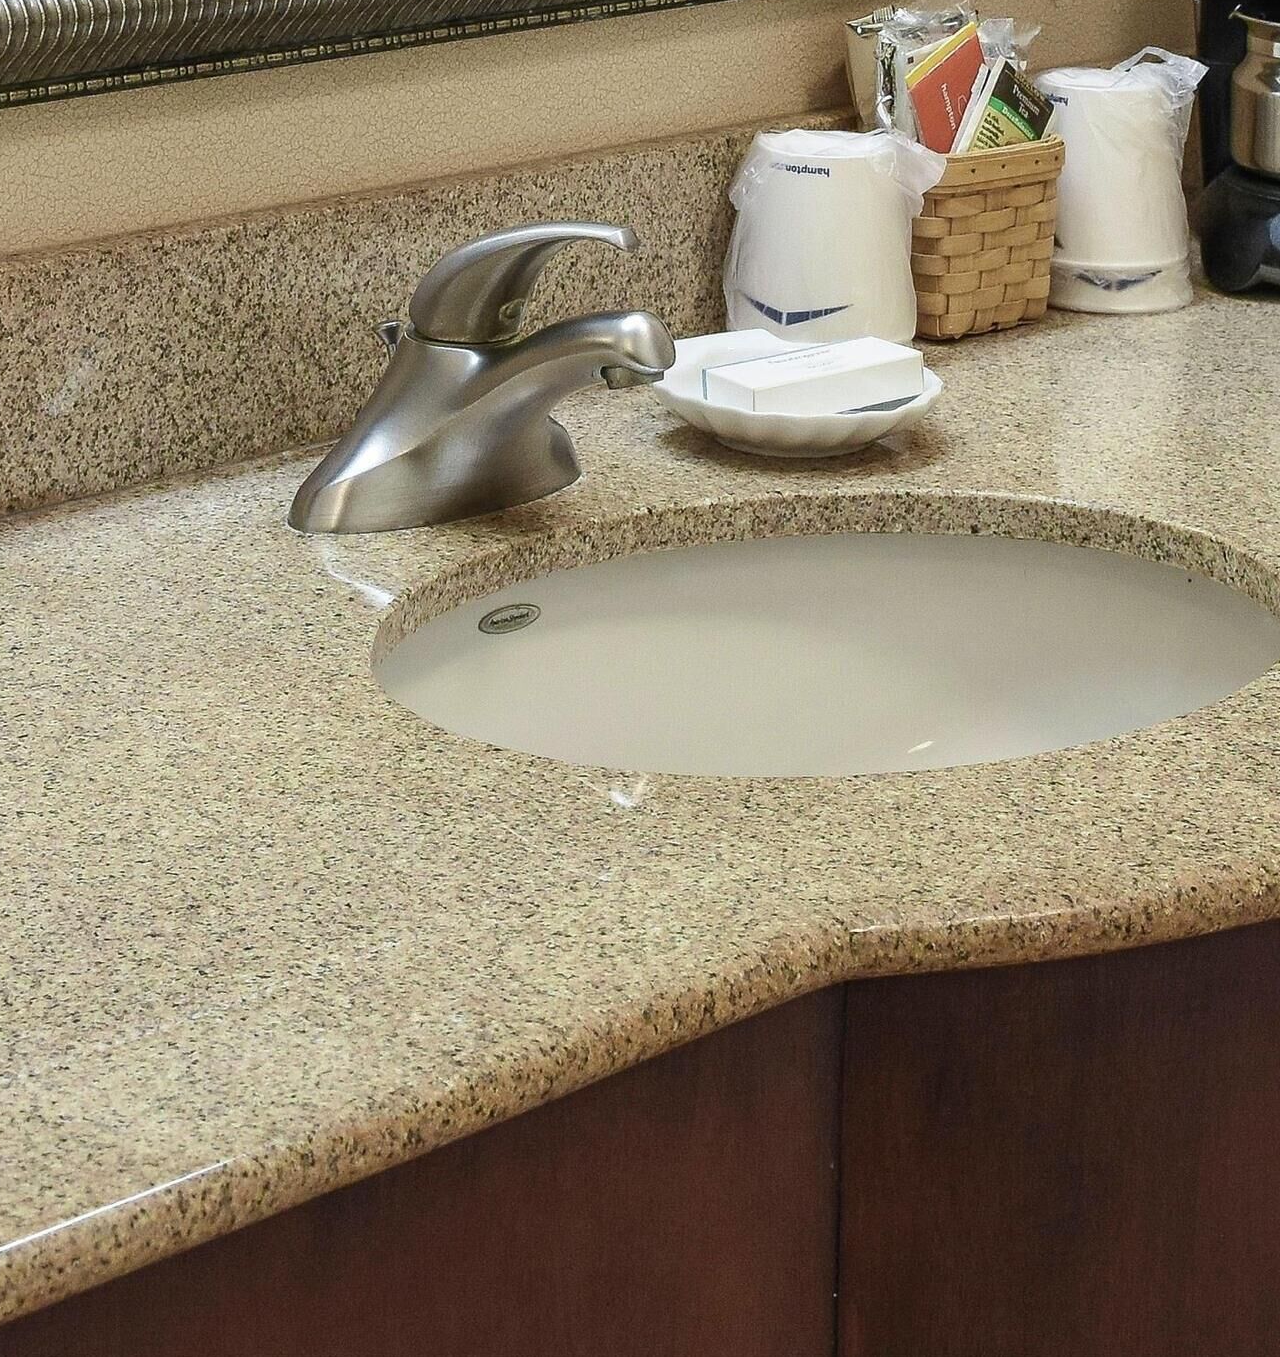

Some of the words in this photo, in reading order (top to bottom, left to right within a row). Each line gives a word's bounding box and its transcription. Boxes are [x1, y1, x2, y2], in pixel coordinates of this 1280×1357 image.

[940, 82, 957, 130] hampton
[1017, 102, 1030, 119] Tea
[785, 164, 830, 178] hampton
